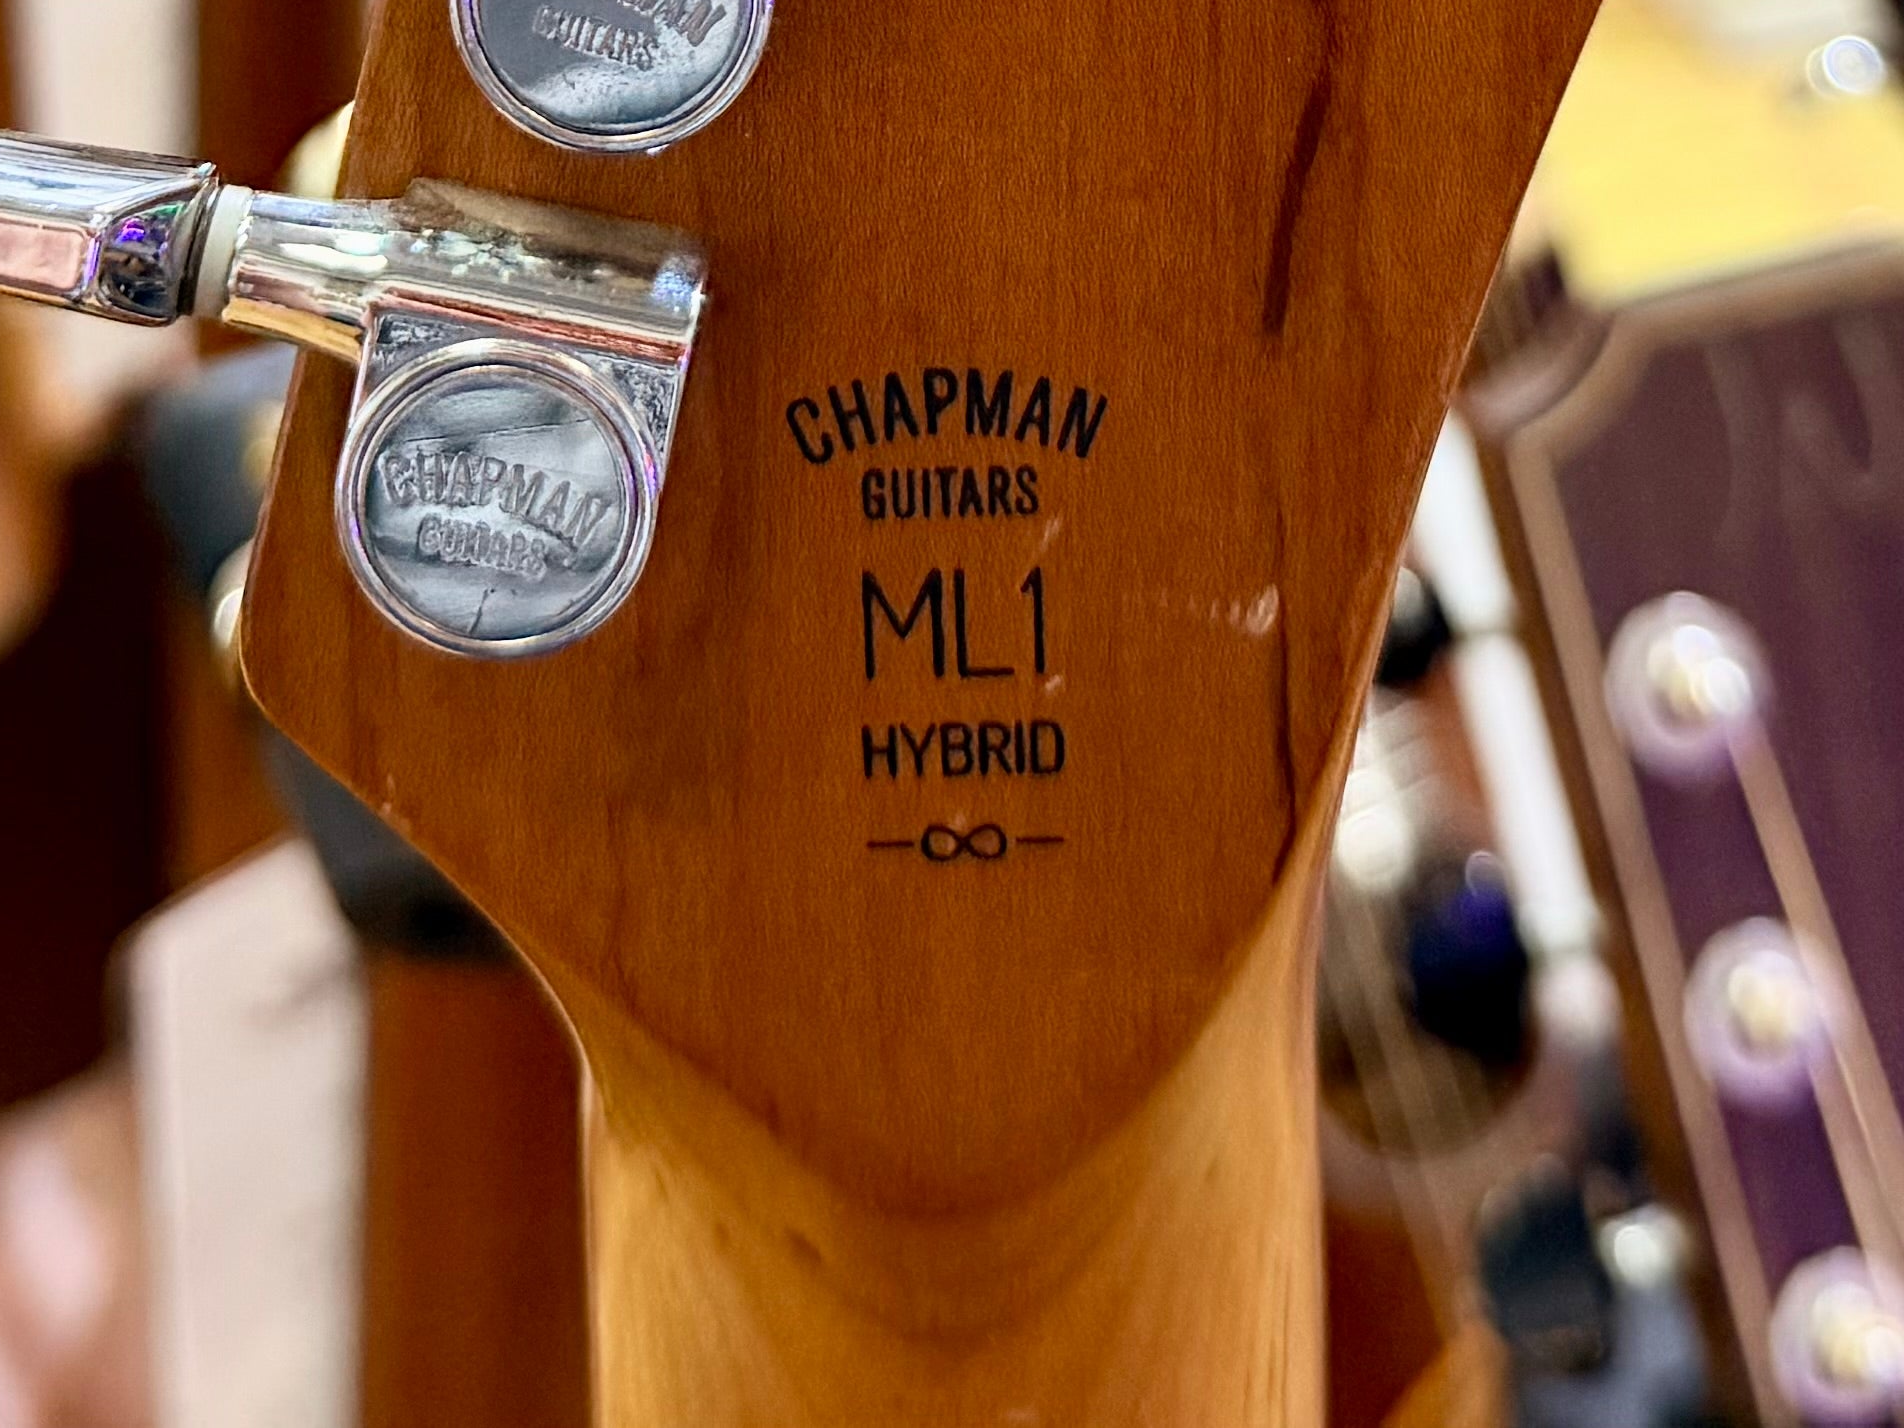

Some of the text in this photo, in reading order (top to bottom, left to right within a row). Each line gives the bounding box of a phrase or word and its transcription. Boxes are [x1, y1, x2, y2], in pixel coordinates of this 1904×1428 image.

[532, 5, 659, 72] GUITARS
[786, 367, 1108, 465] CHAPMAN
[377, 447, 612, 547] CHAPMAN
[861, 465, 1040, 520] GUITARS
[416, 512, 548, 581] GUITARS
[861, 566, 1046, 681] ML1
[861, 718, 1066, 779] HYBRID
